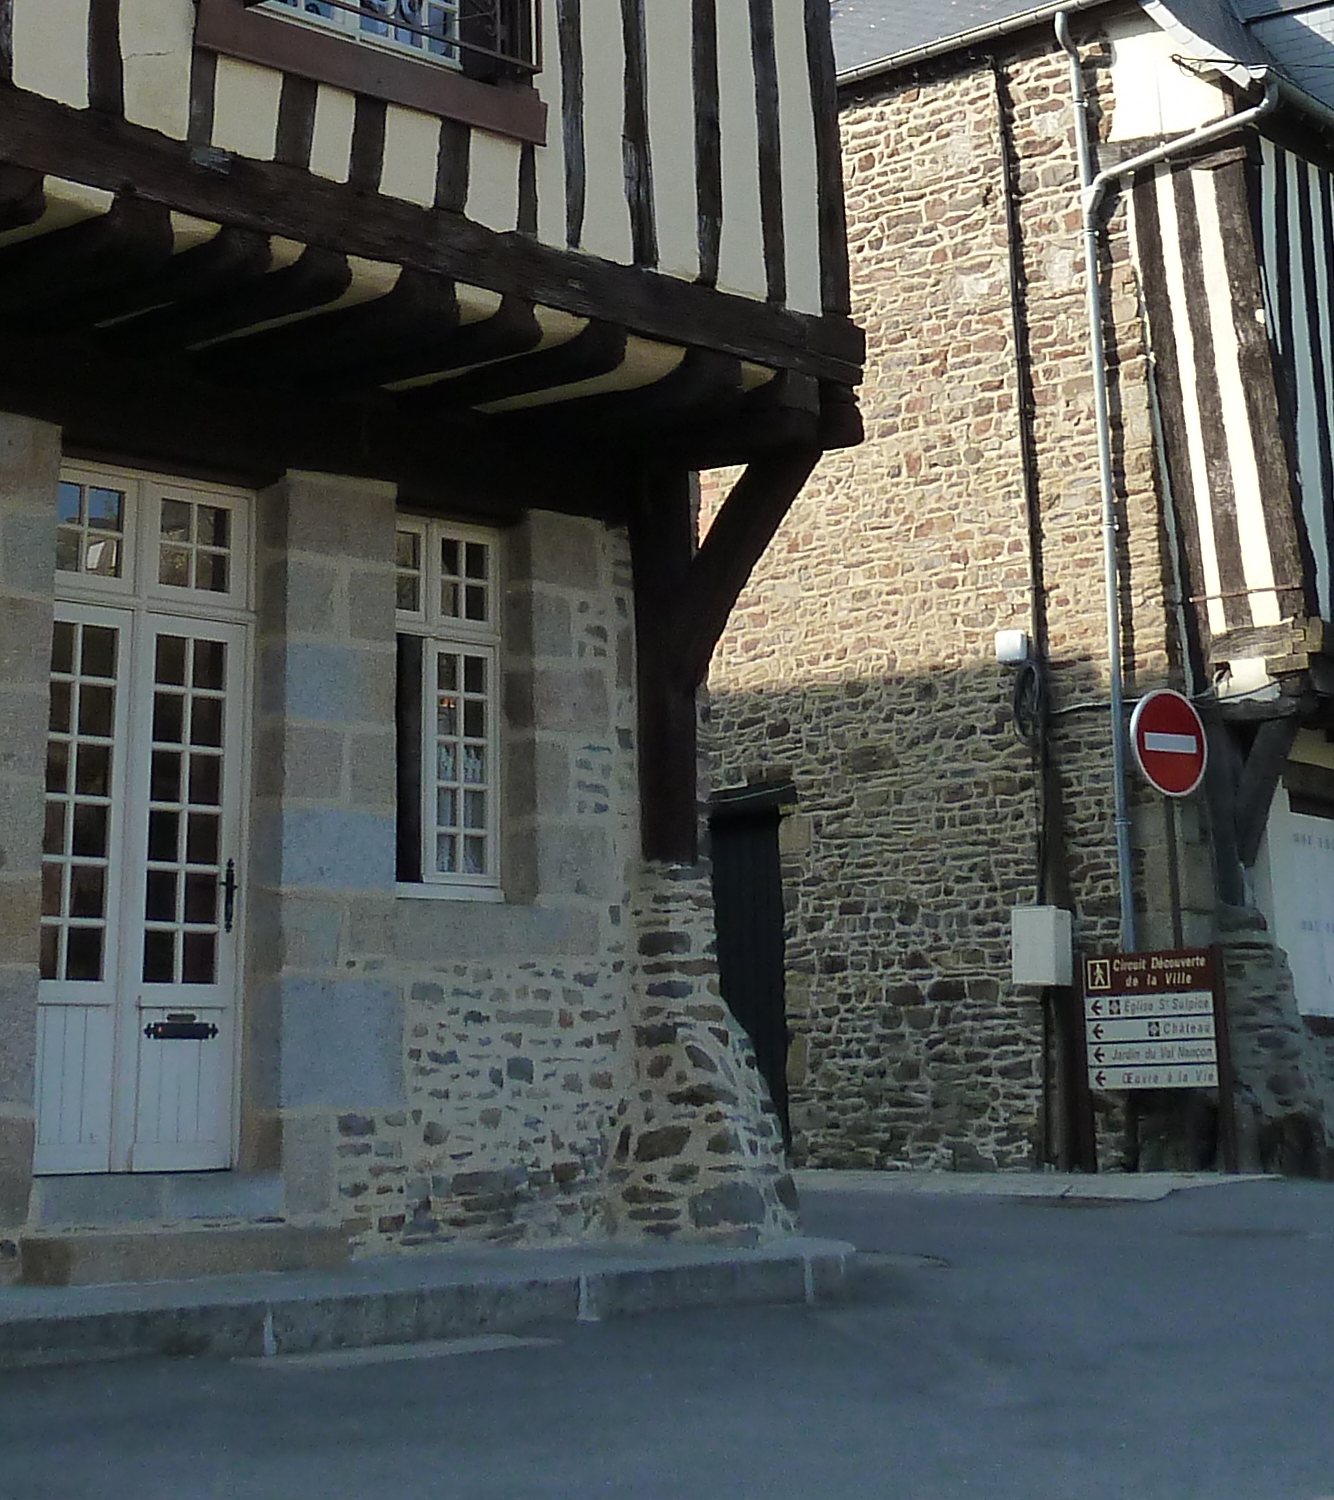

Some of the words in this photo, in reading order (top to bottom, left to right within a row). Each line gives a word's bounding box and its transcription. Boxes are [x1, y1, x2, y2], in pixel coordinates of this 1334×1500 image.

[1113, 958, 1146, 972] Circuit
[1151, 956, 1206, 969] Découverte
[1125, 975, 1139, 987] de
[1147, 974, 1157, 986] la
[1165, 972, 1192, 984] Ville
[1172, 997, 1209, 1011] Sulpice
[1163, 1022, 1210, 1034] Château
[1112, 1047, 1140, 1060] Jardin
[1145, 1047, 1156, 1059] du
[1160, 1046, 1174, 1058] Val
[1179, 1070, 1188, 1082] la
[1196, 1069, 1214, 1082] Vie
